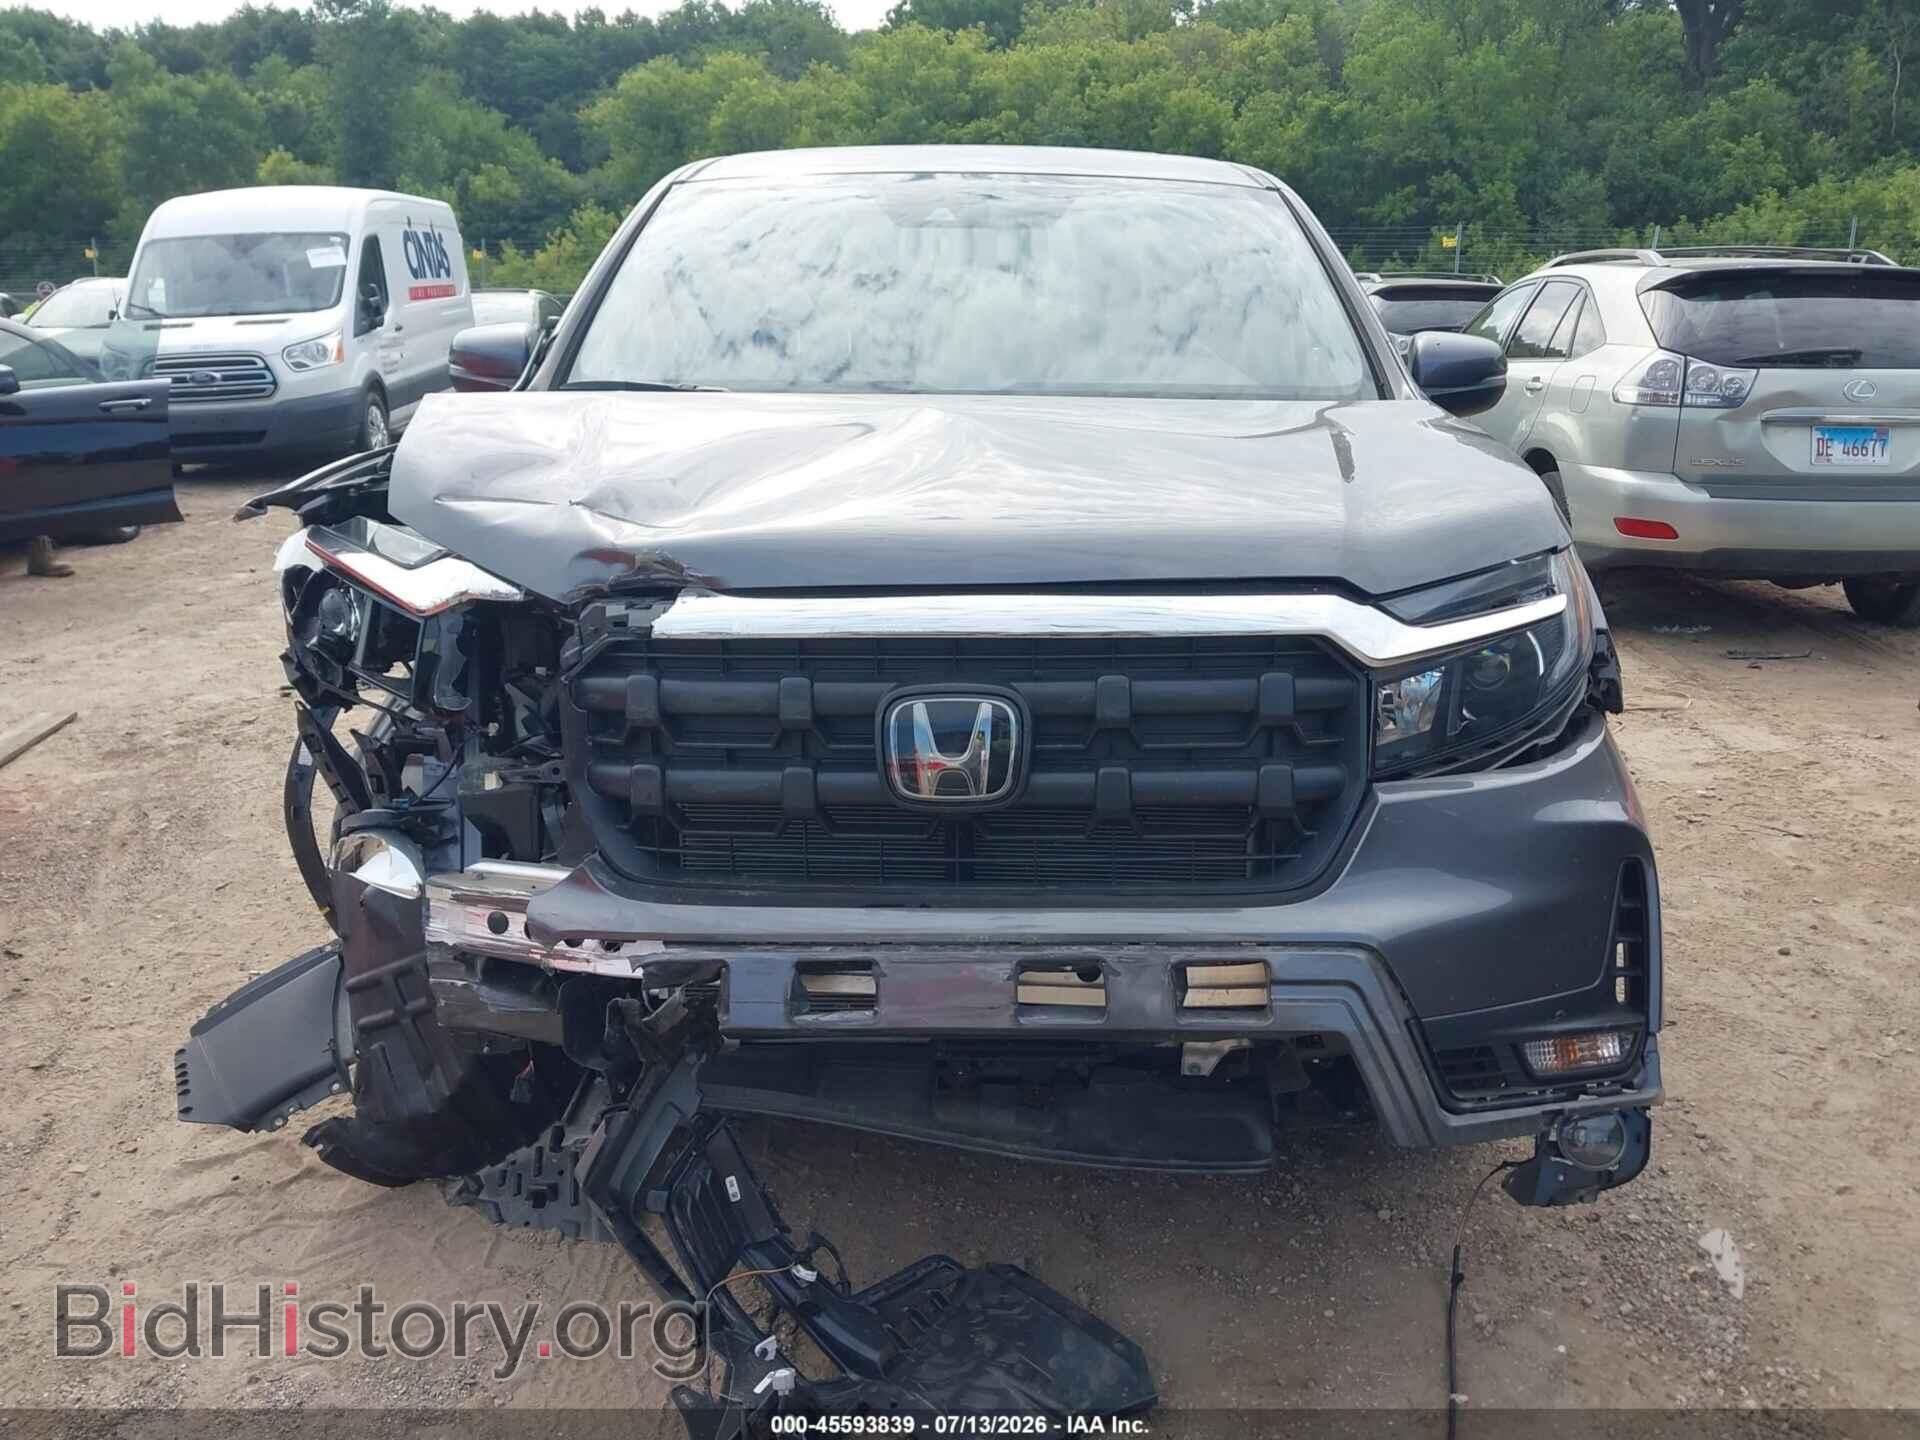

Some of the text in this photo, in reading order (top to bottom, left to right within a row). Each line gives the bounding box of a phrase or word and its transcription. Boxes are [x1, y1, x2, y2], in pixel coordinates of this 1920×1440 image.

[403, 216, 451, 280] CINTAS
[1816, 437, 1887, 457] DE 46677
